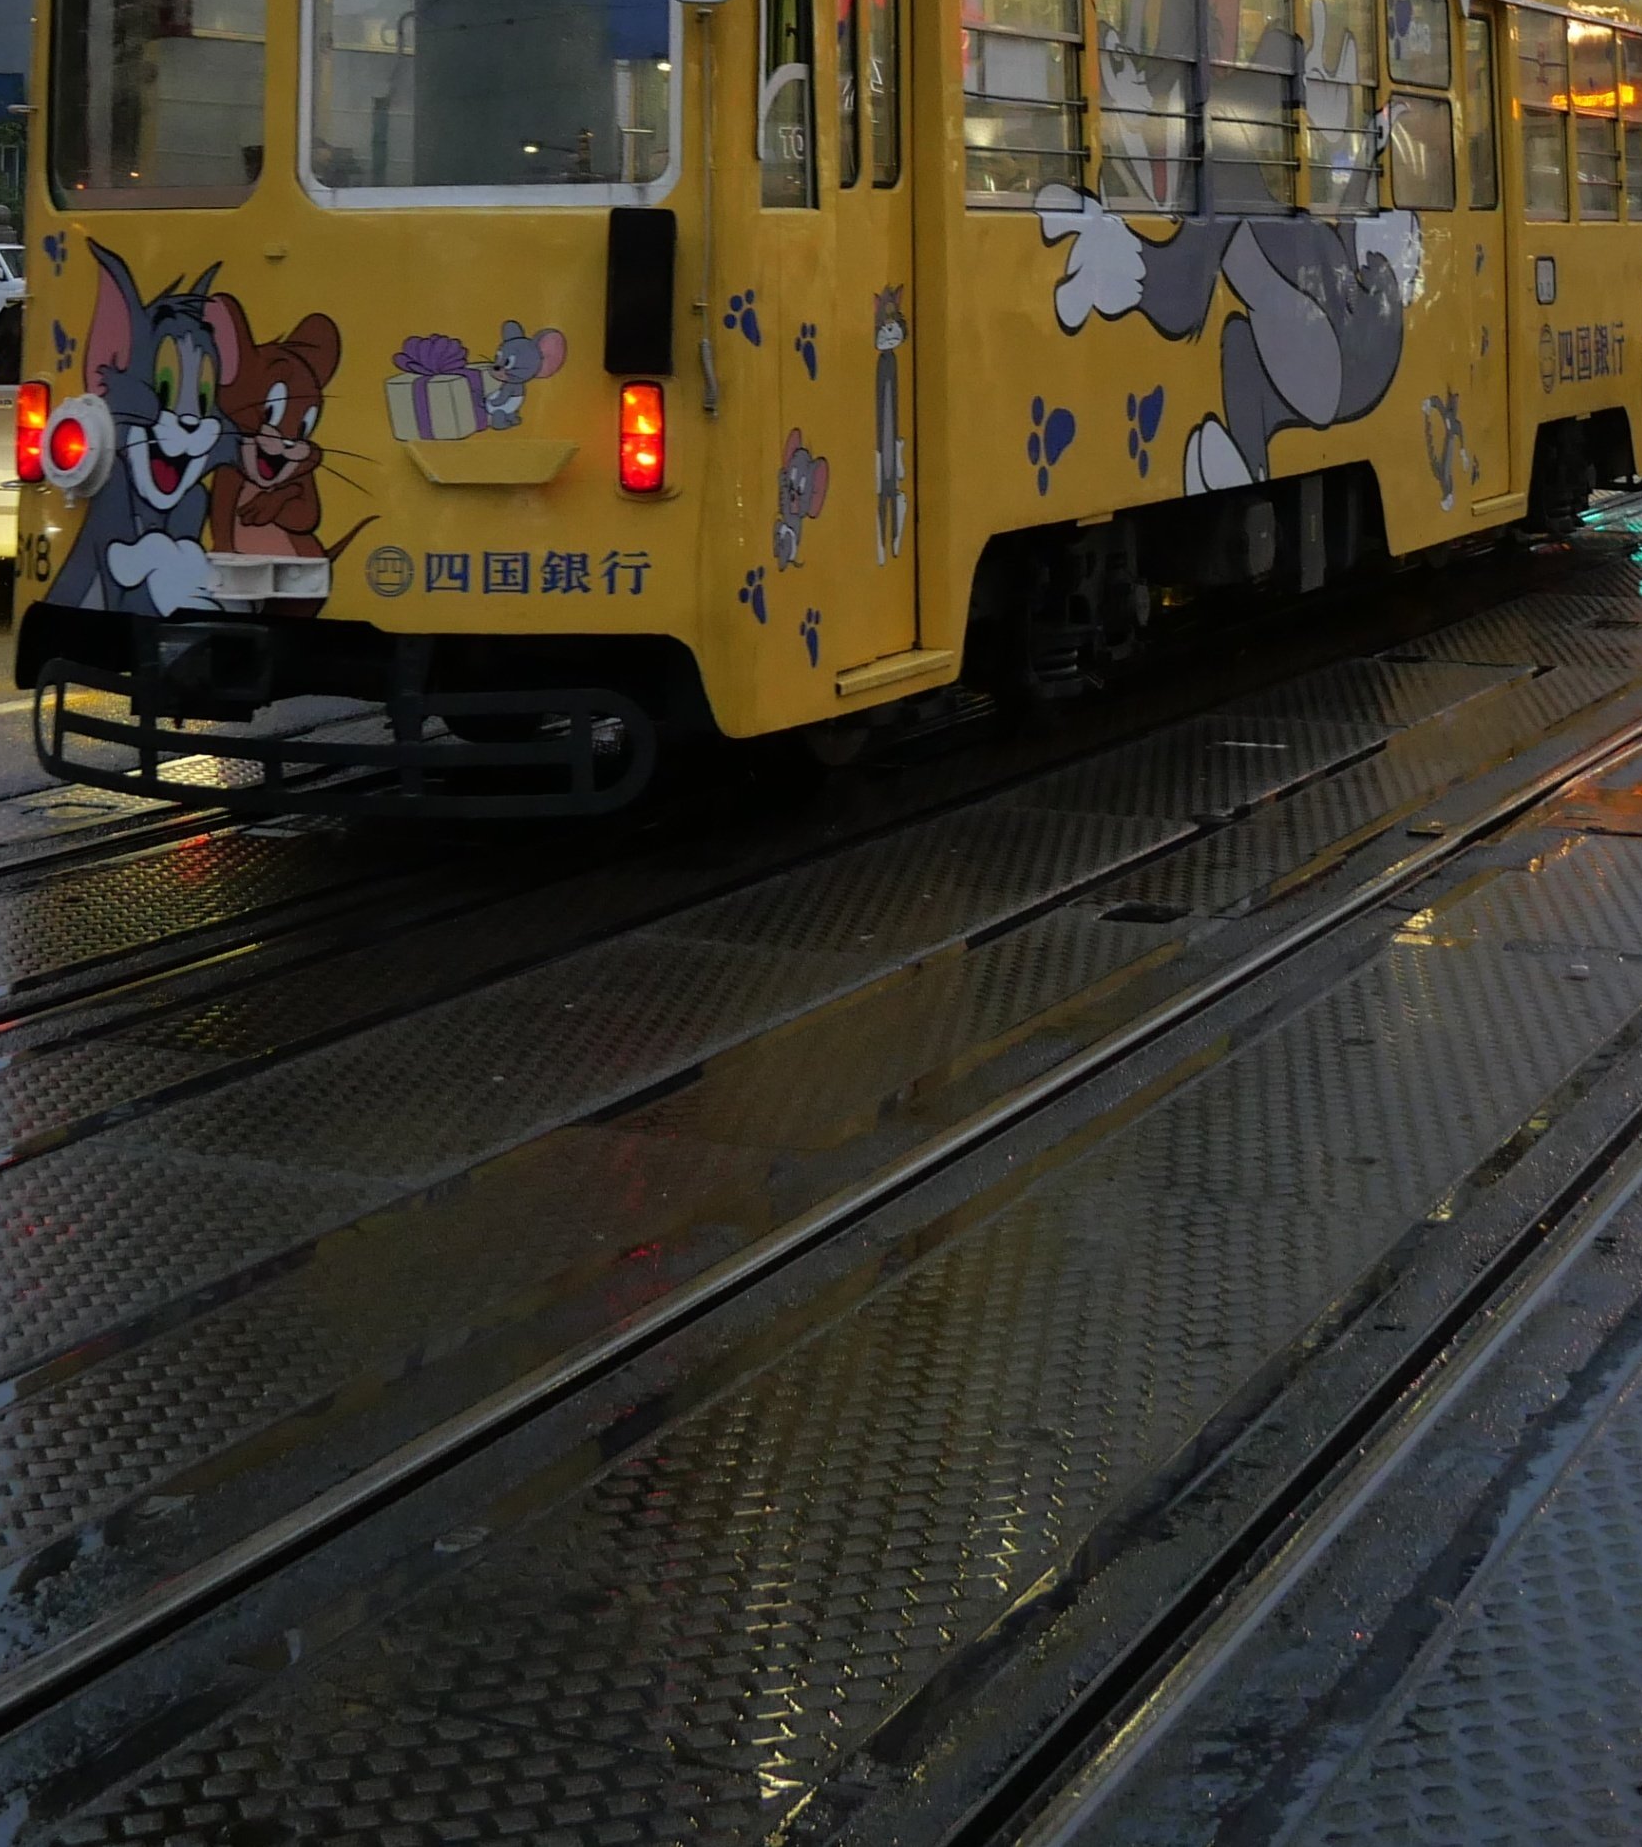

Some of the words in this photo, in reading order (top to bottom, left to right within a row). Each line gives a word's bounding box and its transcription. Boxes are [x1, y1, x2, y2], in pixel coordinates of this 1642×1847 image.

[1558, 321, 1625, 383] 四国銀行
[424, 549, 652, 596] 四国銀行
